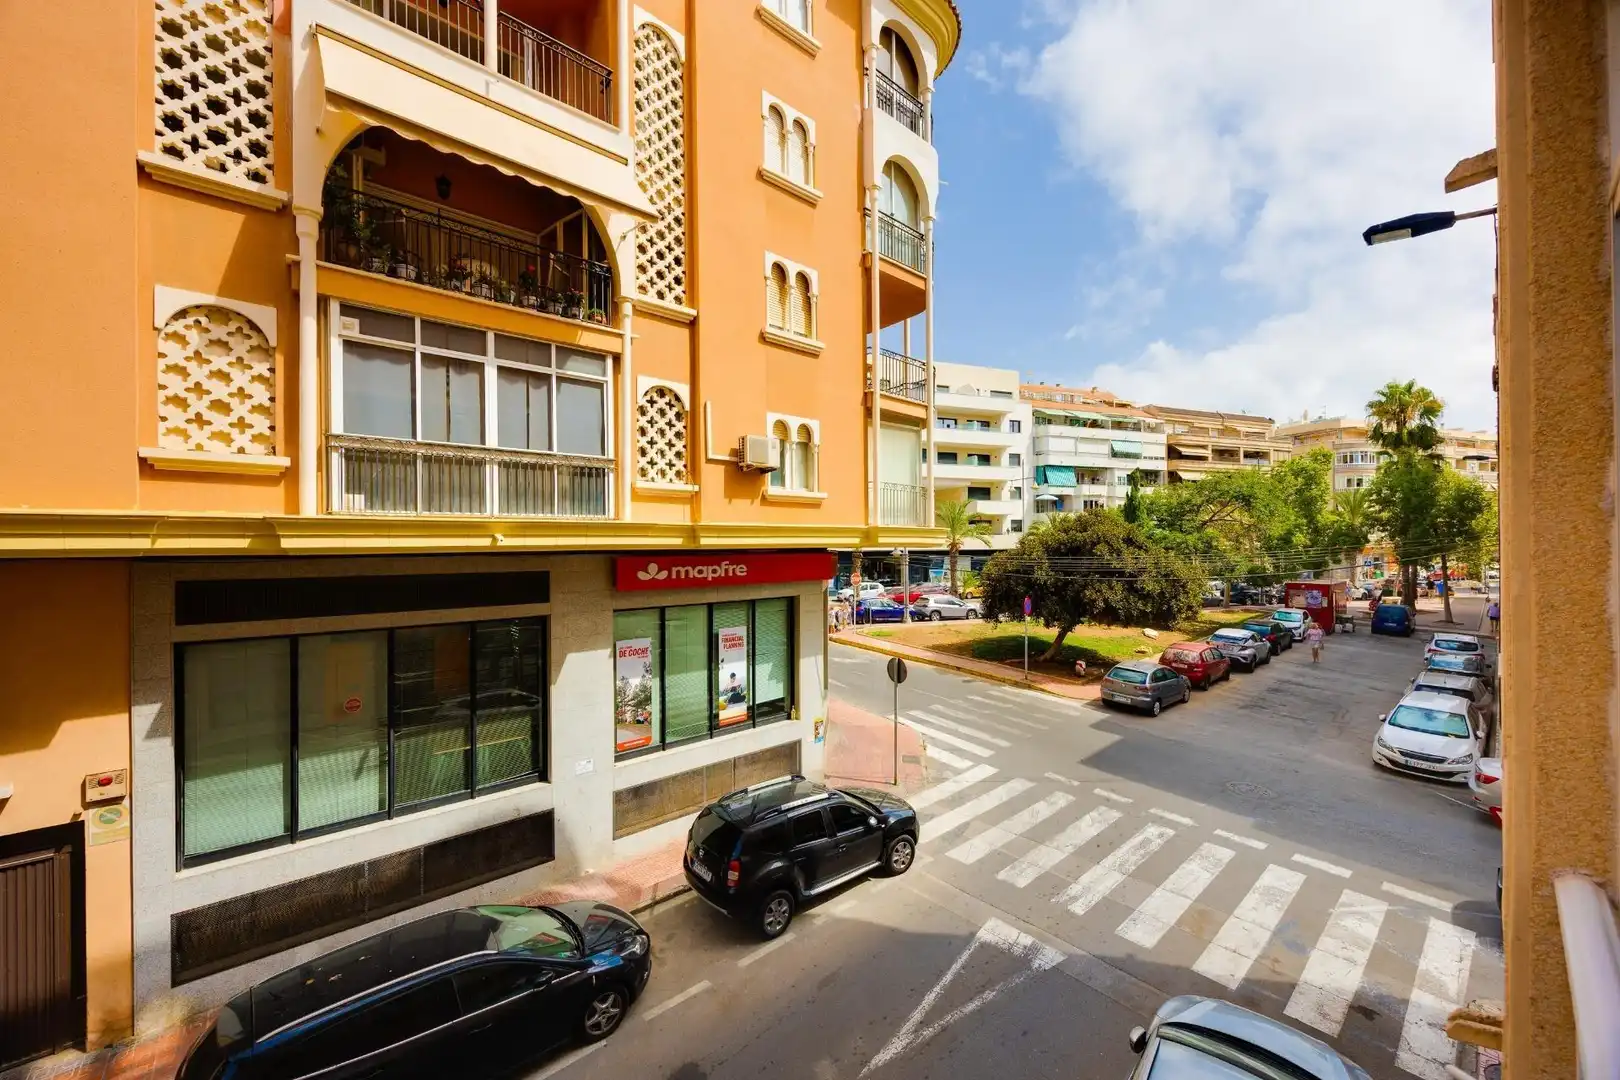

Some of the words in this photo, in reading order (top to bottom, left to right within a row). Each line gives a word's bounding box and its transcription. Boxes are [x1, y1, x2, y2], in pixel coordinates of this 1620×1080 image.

[671, 561, 747, 581] mapfre
[618, 649, 628, 658] DE
[628, 647, 649, 657] COCHE
